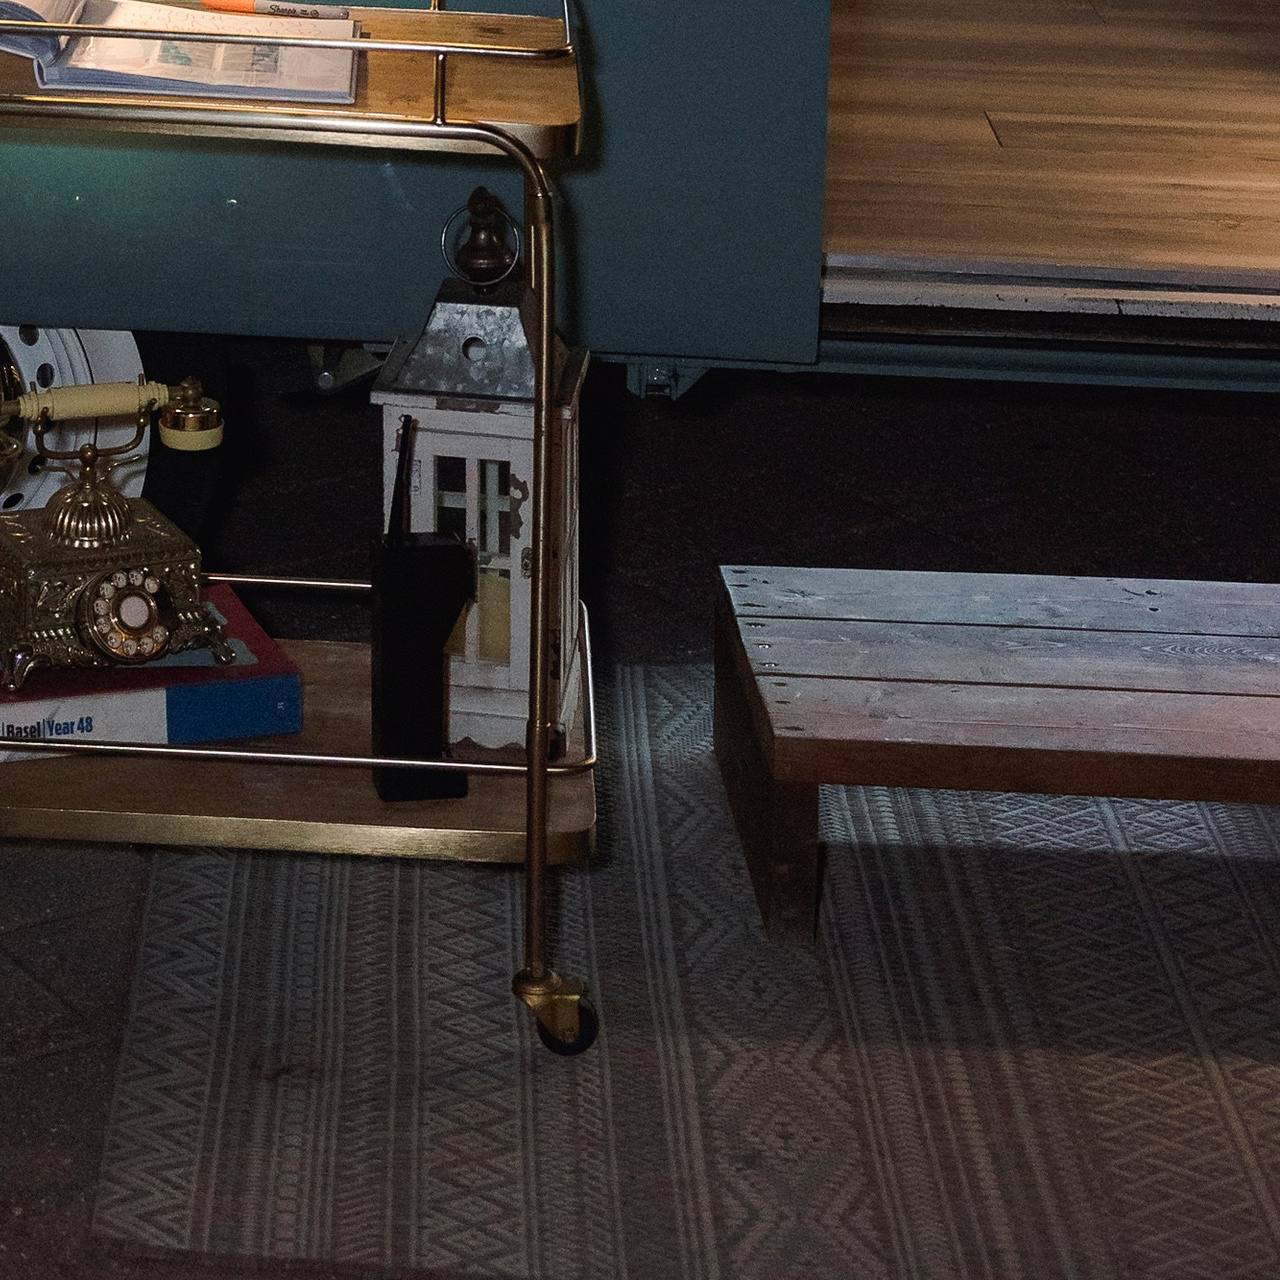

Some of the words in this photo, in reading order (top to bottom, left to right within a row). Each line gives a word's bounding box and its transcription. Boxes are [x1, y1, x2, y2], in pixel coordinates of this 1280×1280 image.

[6, 721, 41, 738] Basel
[46, 719, 75, 736] Year
[76, 716, 93, 733] 48
